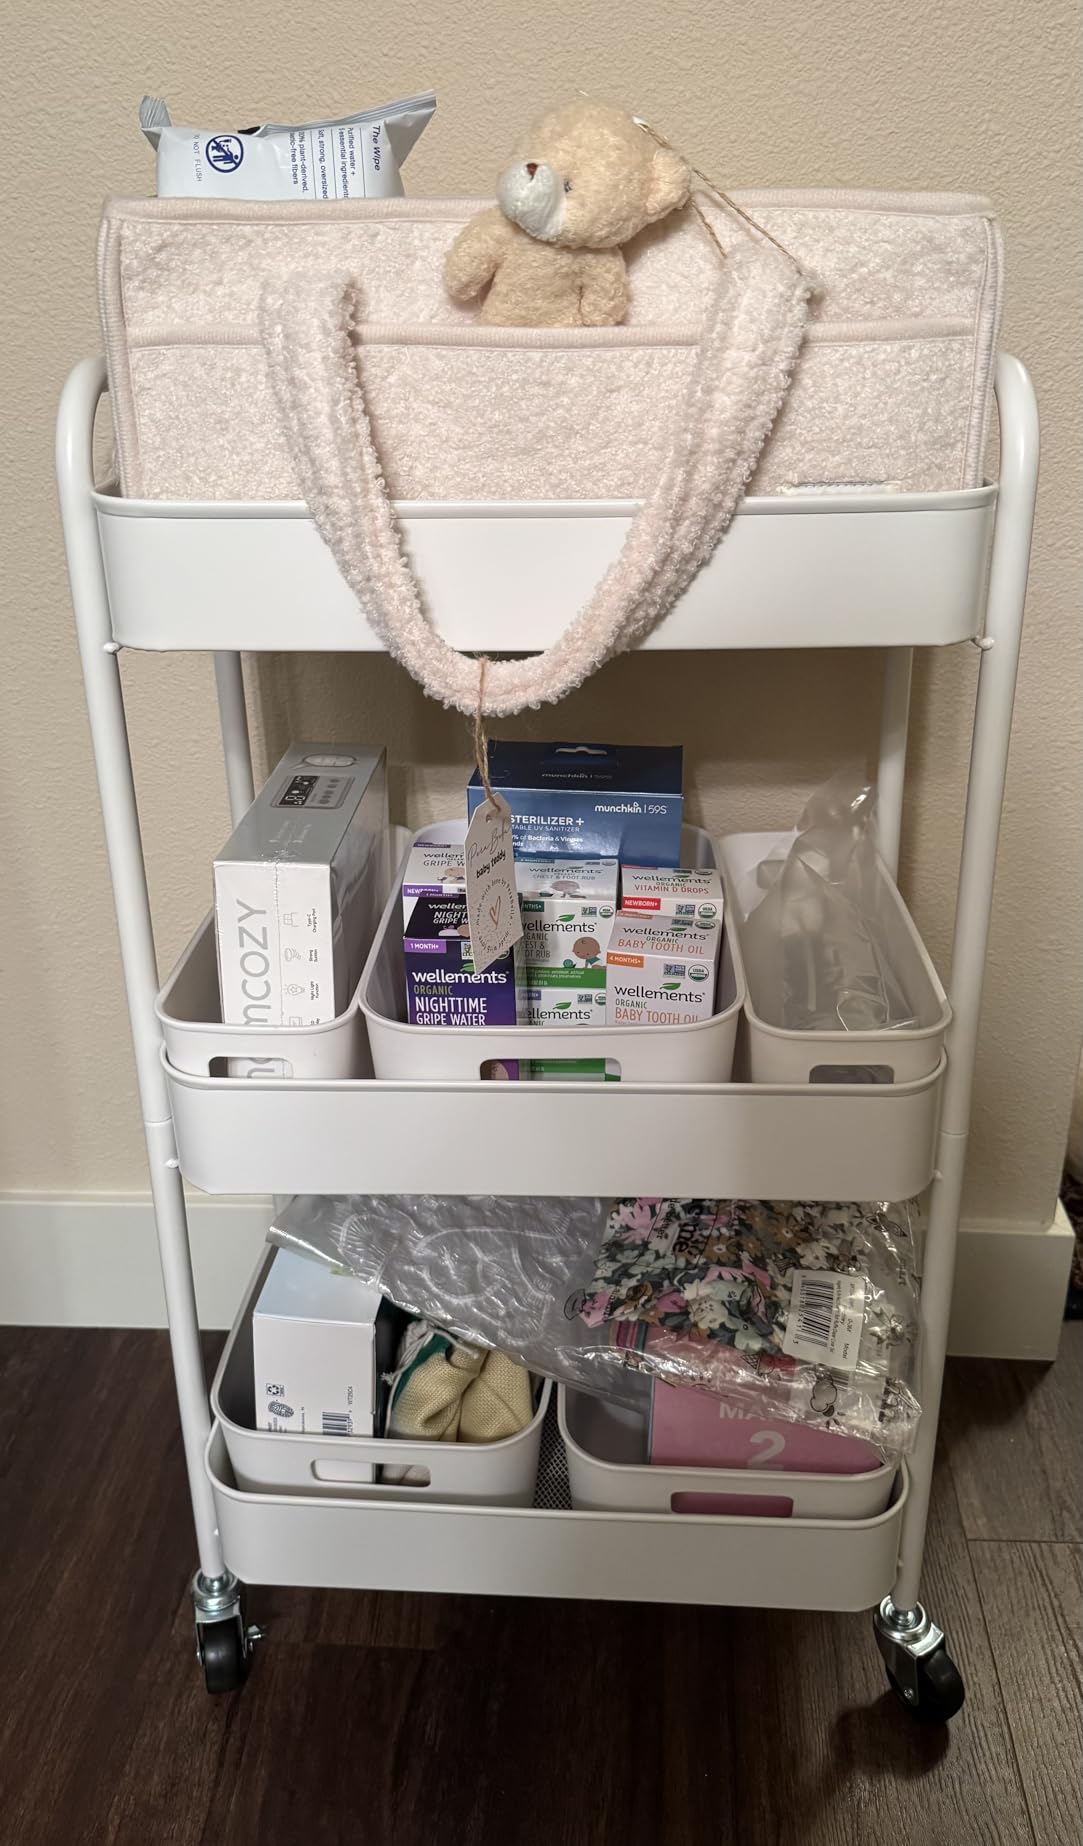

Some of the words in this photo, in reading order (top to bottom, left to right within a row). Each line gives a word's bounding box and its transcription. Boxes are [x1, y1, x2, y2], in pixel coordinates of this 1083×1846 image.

[371, 125, 381, 145] The
[339, 131, 347, 160] essential
[348, 150, 356, 170] water
[371, 146, 381, 171] Wipe
[194, 159, 202, 182] FLUSH
[320, 165, 328, 199] oversized
[595, 801, 642, 814] munchkin
[648, 804, 667, 815] 59S
[476, 864, 491, 880] baby
[491, 849, 507, 868] teddy
[632, 875, 711, 884] wellements
[434, 911, 467, 919] NIGHT
[623, 927, 707, 941] wellements
[646, 936, 679, 944] ORGANIC
[525, 941, 538, 949] EST
[618, 938, 647, 950] BABY
[650, 942, 684, 953] TOOTH
[687, 945, 705, 954] OIL
[536, 950, 551, 958] RUB
[412, 969, 509, 983] wellements
[413, 985, 453, 995] ORGANIC
[614, 985, 703, 1003] wellements
[415, 997, 488, 1013] NIGHTTIME
[615, 998, 648, 1009] ORGANIC
[416, 1013, 447, 1025] GRIPE
[449, 1014, 486, 1026] WATER
[527, 1008, 592, 1020] ellements
[615, 1007, 643, 1021] BABY
[646, 1010, 680, 1024] TOOTH
[750, 1430, 785, 1471] 2
